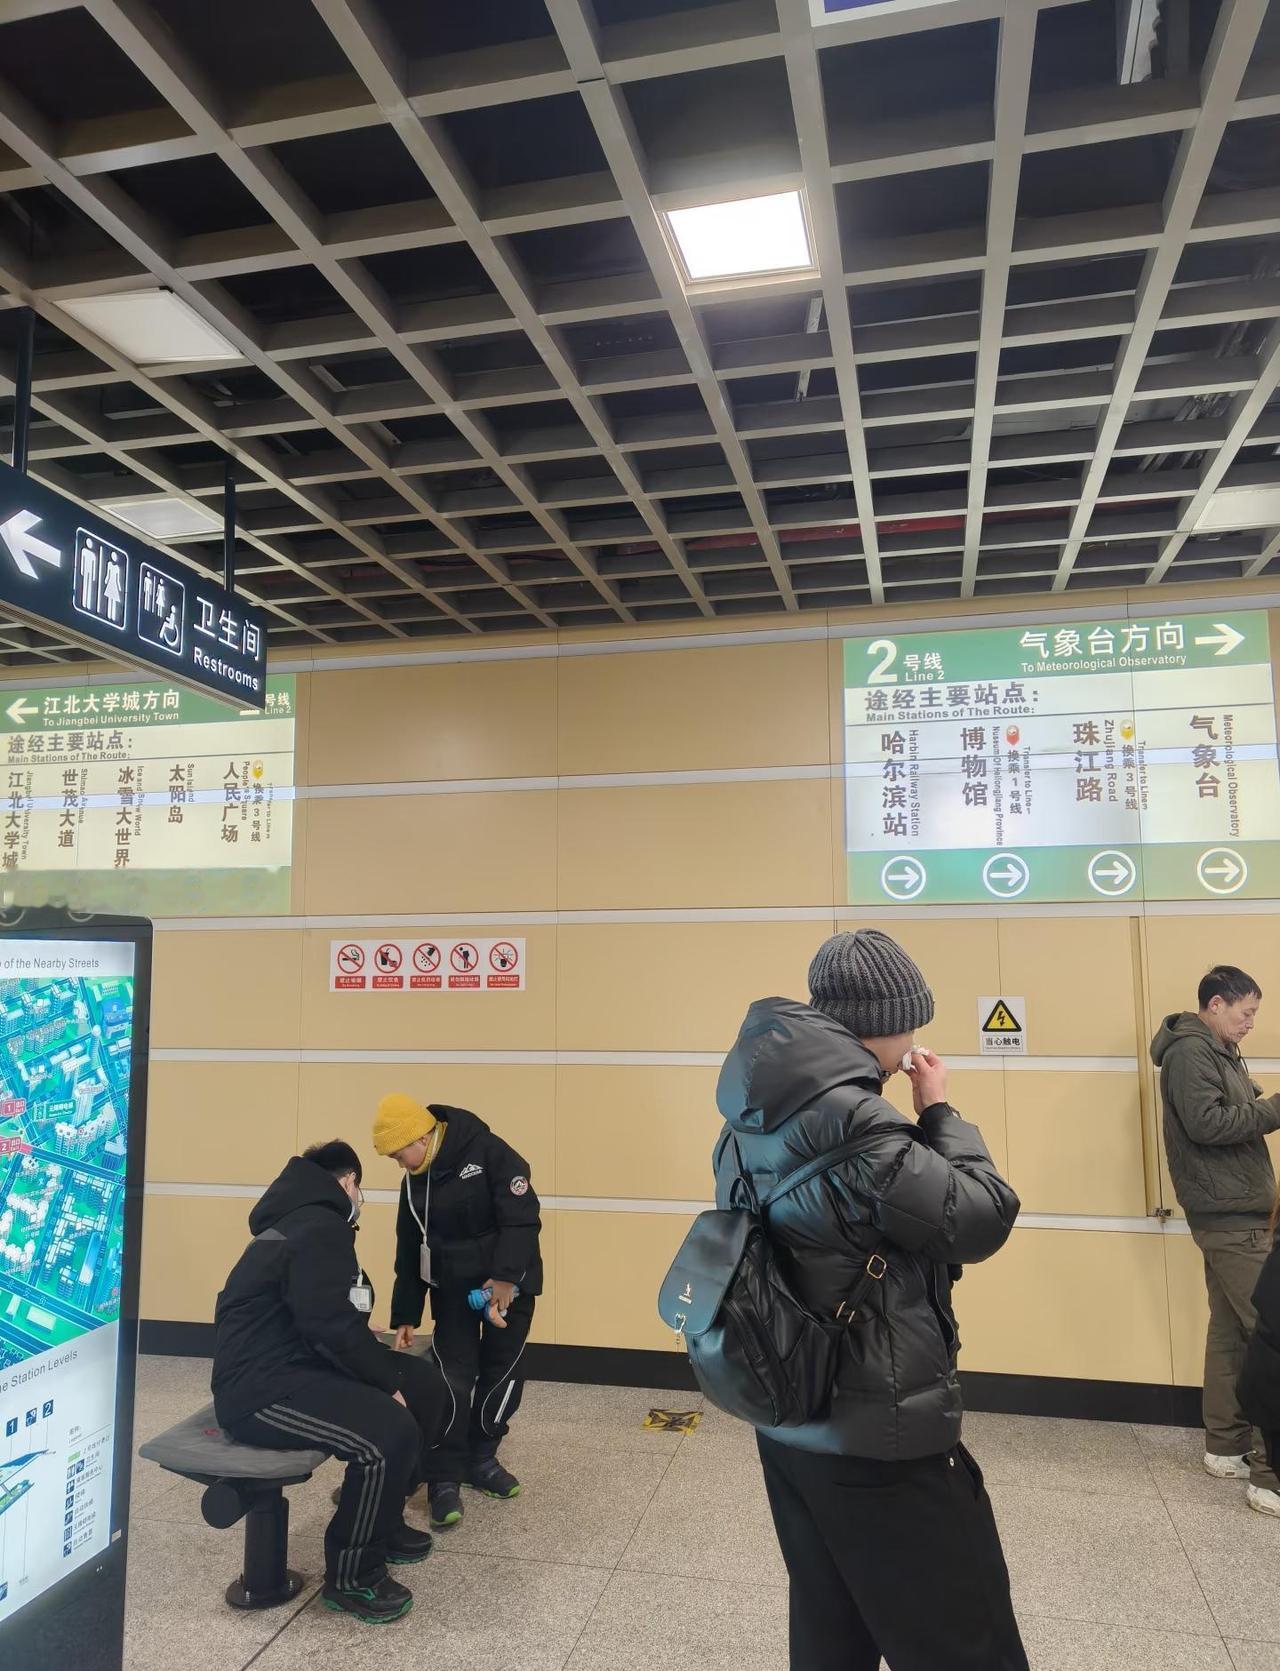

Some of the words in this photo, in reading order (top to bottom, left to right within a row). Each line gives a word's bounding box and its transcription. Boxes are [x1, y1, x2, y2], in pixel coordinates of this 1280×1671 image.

[193, 596, 260, 661] 卫生间
[1019, 621, 1185, 658] 气象台方向
[193, 646, 259, 691] Restrooms
[866, 639, 898, 684] 2
[903, 652, 943, 671] 号线
[905, 671, 934, 682] Line
[937, 670, 945, 681] 2
[1021, 662, 1035, 673] To
[1037, 657, 1116, 673] Meteorological
[1118, 654, 1187, 669] Observatory
[43, 688, 180, 715] 江北大学城方向
[265, 692, 290, 707] 号线
[265, 707, 284, 715] Line
[285, 705, 292, 714] 2
[864, 681, 1039, 711] 途经主要站点：
[43, 718, 55, 727] To
[56, 716, 99, 727] Jiangbei
[100, 713, 151, 724] University
[153, 711, 180, 720] Town
[866, 712, 895, 723] Main
[897, 709, 950, 721] Stations
[952, 708, 965, 718] of
[967, 706, 991, 717] The
[993, 705, 1036, 716] Route:
[7, 729, 133, 754] 途经主要站点：
[7, 755, 29, 764] Main
[30, 753, 68, 763] Stations
[70, 752, 80, 761] of
[81, 752, 98, 761] The
[100, 750, 131, 761] Route:
[908, 729, 919, 761] Harbin
[1103, 719, 1116, 770] Zhujiang
[1189, 715, 1220, 799] 气象台
[1223, 714, 1238, 780] Meteorological
[136, 765, 144, 777] Ice
[186, 763, 195, 778] Sun
[960, 726, 988, 806] 博物馆
[1022, 745, 1031, 779] Transfer
[1073, 720, 1103, 802] 珠江路
[167, 763, 186, 824] 太阳岛
[881, 730, 909, 837] 哈尔滨站
[908, 763, 920, 800] Railway
[1007, 749, 1023, 815] 换乘1号线
[1025, 780, 1032, 788] to
[1106, 772, 1118, 802] Road
[1139, 776, 1147, 785] to
[1139, 785, 1148, 803] Line
[58, 768, 79, 848] 世茂大道
[220, 761, 241, 843] 人民广场
[1025, 789, 1033, 807] Line
[1228, 781, 1240, 838] Observatory
[2, 771, 25, 868] 江北大学城
[114, 765, 135, 867] 冰雪大世界
[134, 814, 143, 836] World
[910, 802, 920, 837] Station
[994, 813, 1004, 846] Province
[21, 841, 29, 860] Town
[3, 957, 15, 969] of
[16, 957, 31, 969] the
[33, 957, 67, 970] Nearby
[68, 957, 100, 968] Streets
[11, 1364, 46, 1388] Station
[48, 1349, 79, 1371] Levels
[44, 1402, 52, 1417] 2
[9, 1420, 15, 1434] 1
